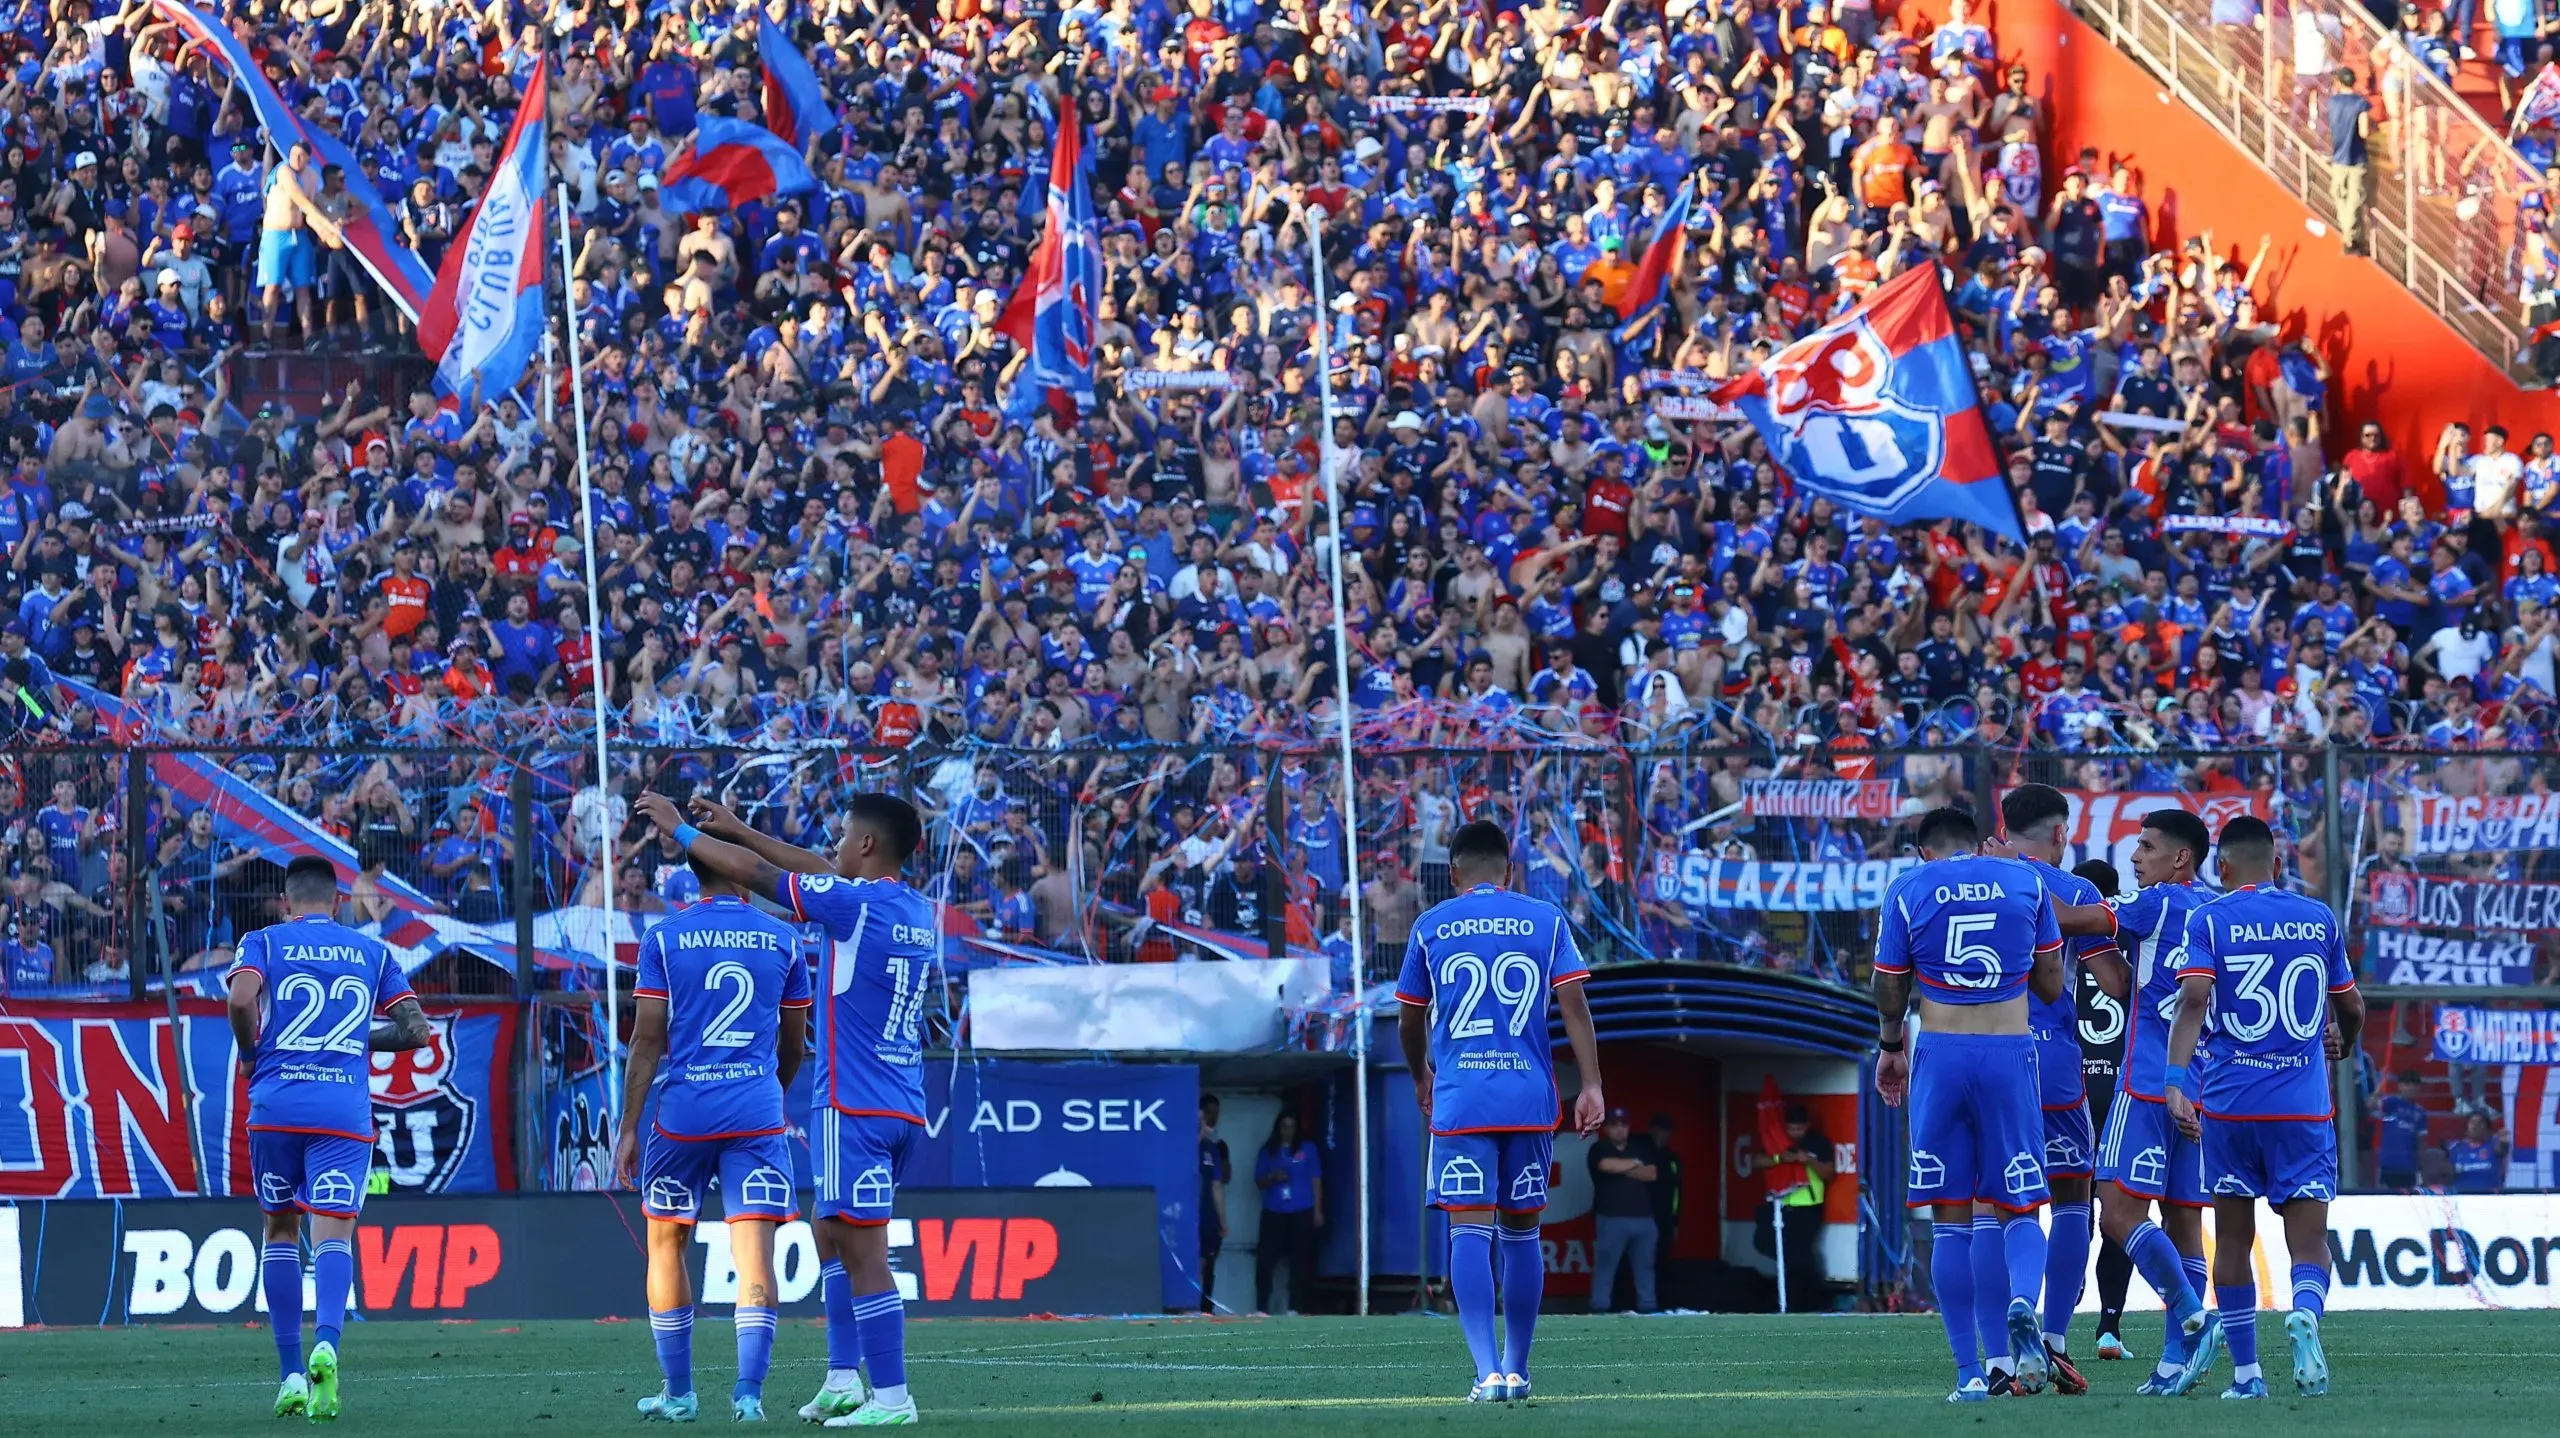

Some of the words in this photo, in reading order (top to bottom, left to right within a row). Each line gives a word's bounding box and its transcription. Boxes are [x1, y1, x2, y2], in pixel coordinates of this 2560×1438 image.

[1803, 414, 1908, 486] U
[2415, 796, 2481, 854] LOS
[1935, 881, 2006, 904] OJEDA
[2417, 876, 2464, 928] LOS
[678, 930, 778, 951] NAVARRETE
[1436, 918, 1534, 940] CORDERO
[2230, 922, 2326, 943] PALACIOS
[282, 945, 367, 966] ZALDIVIA
[1943, 913, 2003, 989] 5
[2378, 929, 2536, 967] HUALKI
[701, 960, 756, 1048] 2
[1440, 951, 1541, 1040] 29
[2222, 953, 2328, 1043] 30
[274, 973, 372, 1057] 22
[317, 1072, 332, 1081] de
[335, 1073, 346, 1083] la
[726, 1069, 742, 1079] de
[1457, 1059, 1496, 1070] somos
[1497, 1058, 1511, 1070] de
[2087, 1067, 2101, 1075] de
[2103, 1066, 2114, 1075] la
[1062, 1099, 1167, 1132] SEK
[123, 1223, 501, 1315] BOVIP
